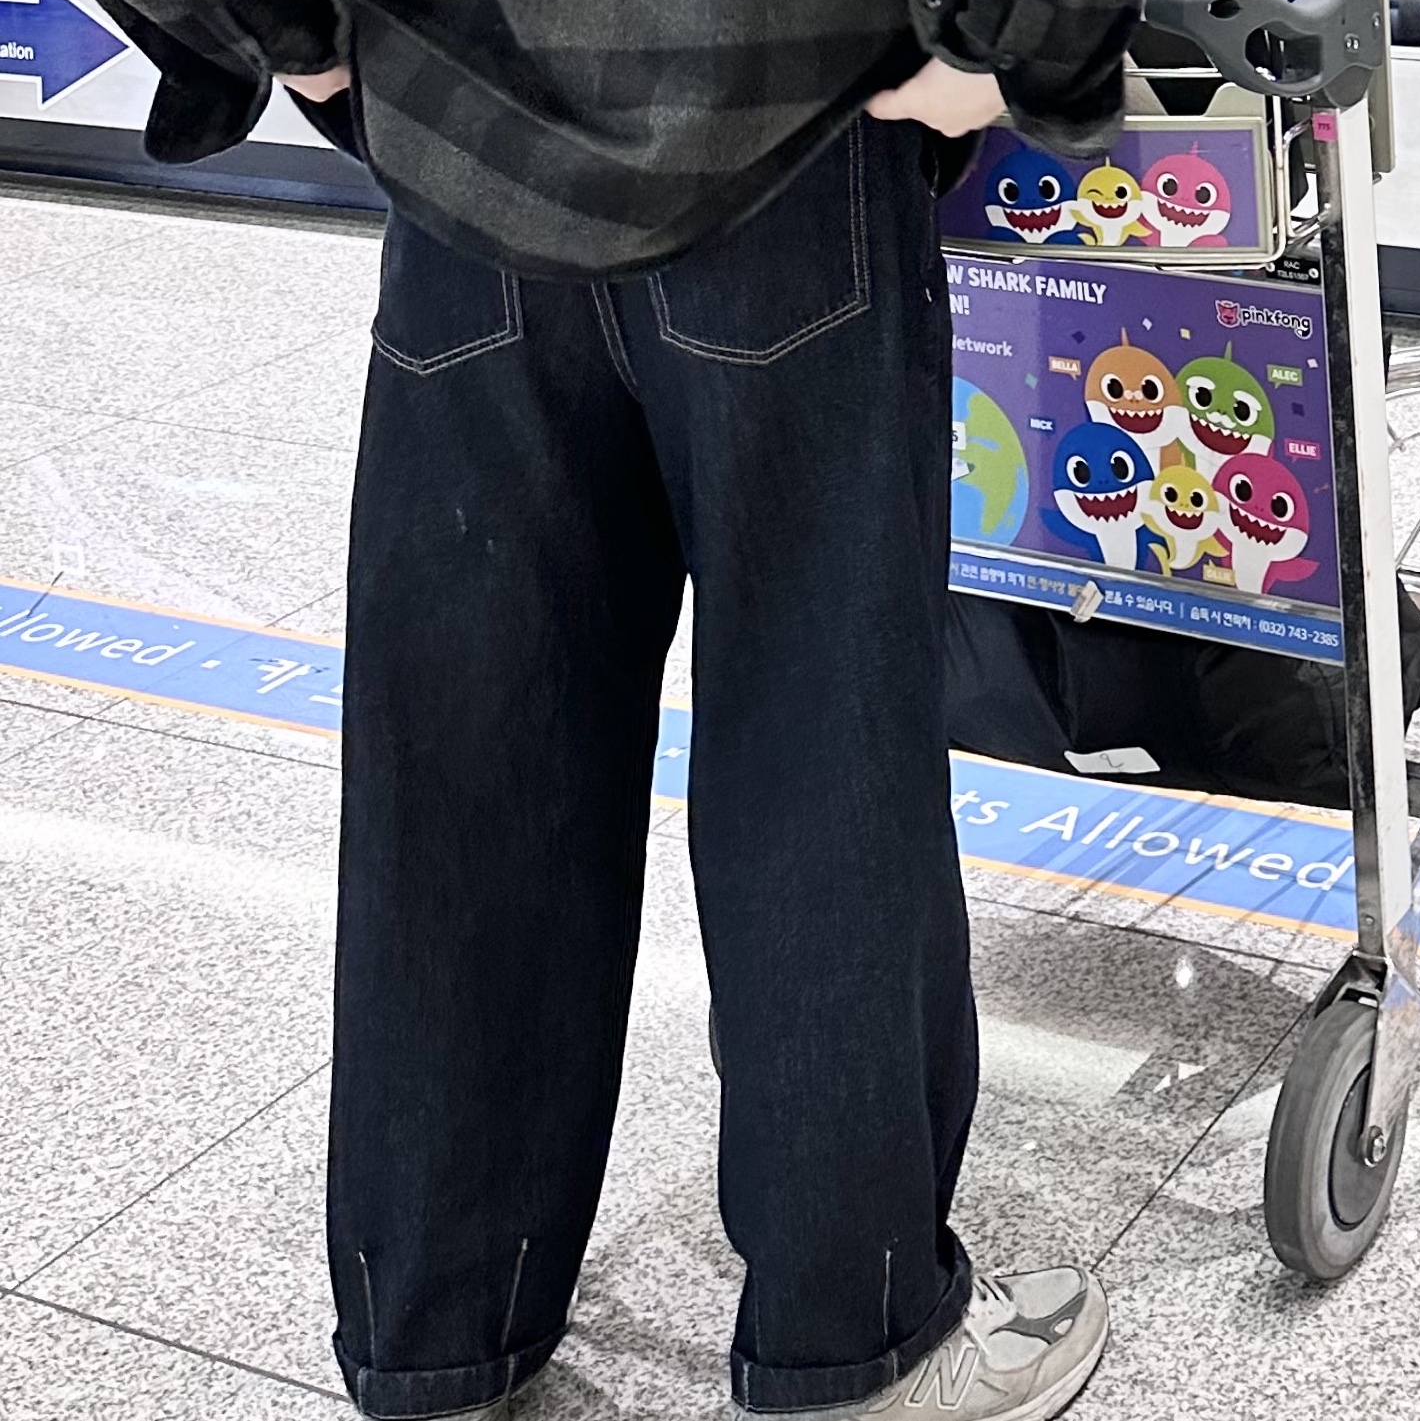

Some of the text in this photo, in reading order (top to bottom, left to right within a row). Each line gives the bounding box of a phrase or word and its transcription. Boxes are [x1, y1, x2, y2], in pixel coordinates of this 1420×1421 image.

[0, 41, 35, 60] ation
[967, 267, 1032, 294] SHARK
[1035, 275, 1107, 304] FAMILY
[1240, 307, 1312, 339] pinkfong
[952, 334, 1013, 357] etwork
[1051, 360, 1079, 372] BELLA
[1271, 368, 1299, 382] ALEC
[1288, 442, 1317, 457] ELLIE
[1125, 593, 1134, 608] 수
[1210, 610, 1221, 625] 시
[1258, 619, 1286, 637] (032)
[1020, 805, 1354, 892] Allowed
